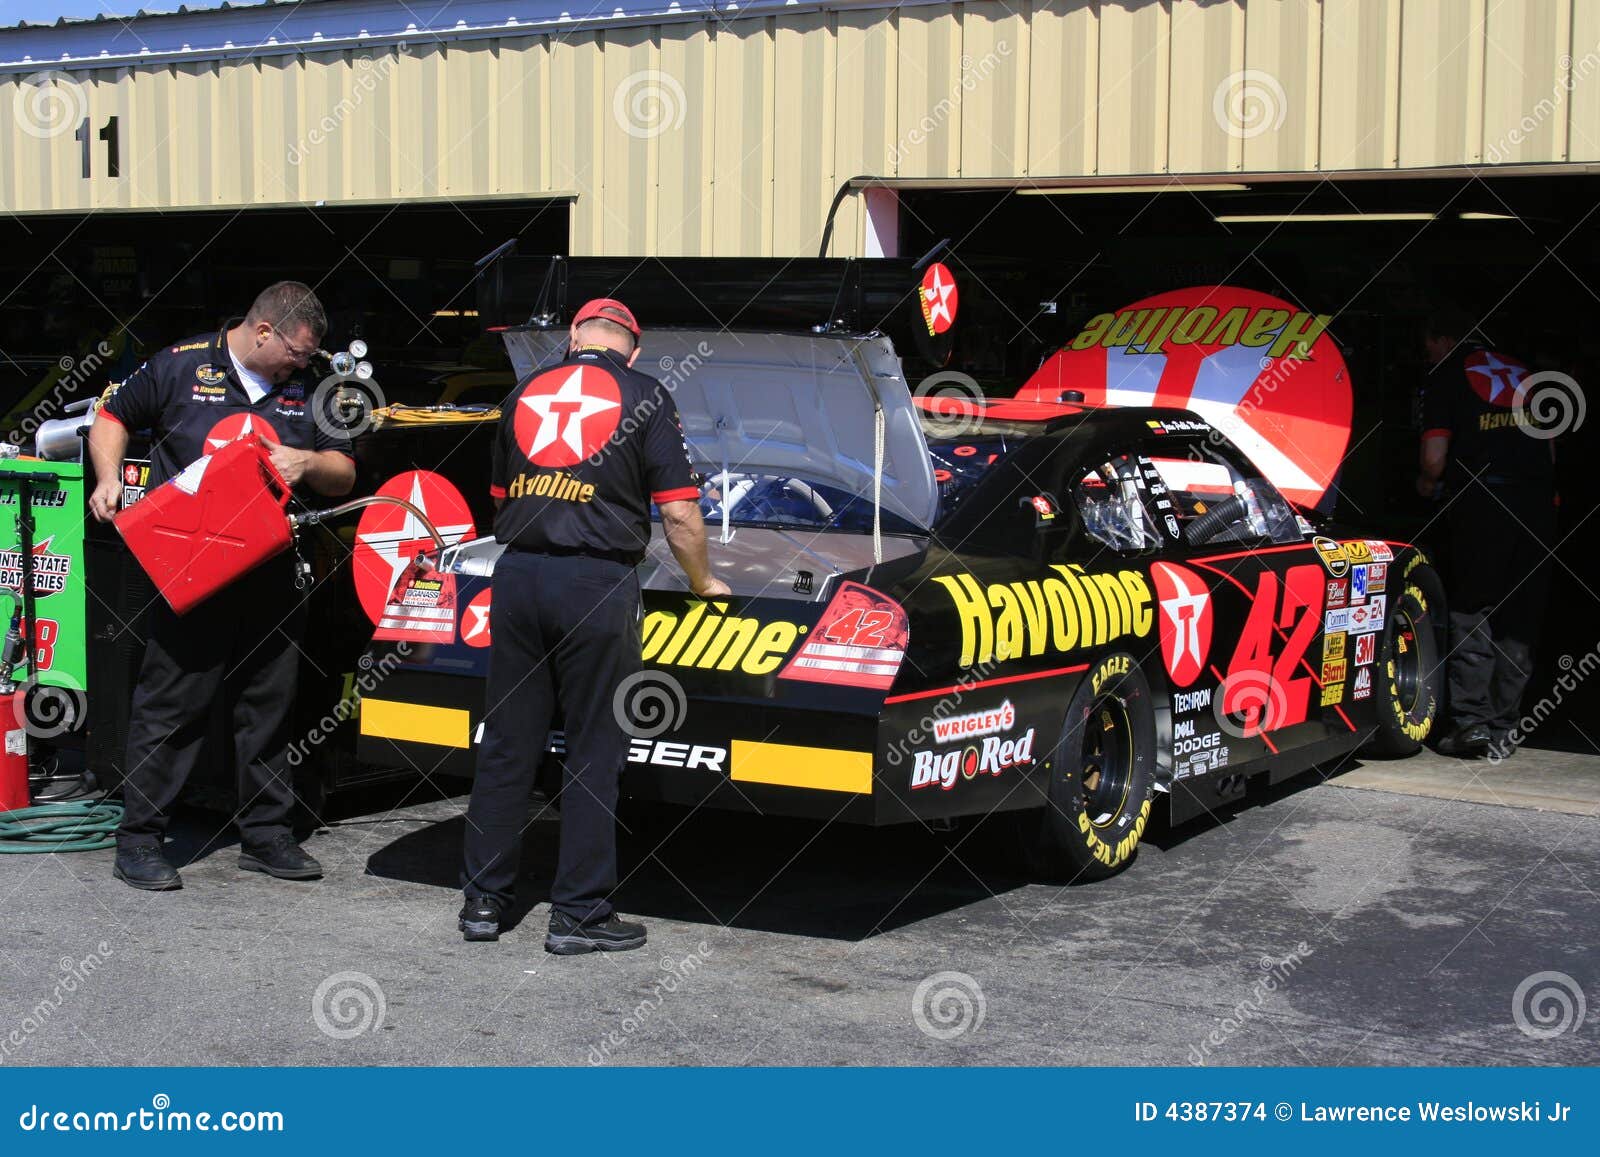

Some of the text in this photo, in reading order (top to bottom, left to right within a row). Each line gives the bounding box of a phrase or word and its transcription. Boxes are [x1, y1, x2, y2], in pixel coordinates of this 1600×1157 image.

[75, 115, 119, 178] 11
[1068, 306, 1333, 361] Havoline
[0, 553, 69, 573] NTESTATE
[1, 571, 64, 590] BATERIES
[824, 607, 895, 648] 42
[930, 563, 1154, 668] Havoline
[641, 600, 798, 675] oline
[1221, 564, 1327, 738] 42
[1356, 634, 1375, 665] 3M
[1091, 656, 1130, 697] EAGLE
[936, 701, 1014, 740] WRIGLEY'S
[1174, 688, 1211, 714] TECHRON
[1173, 732, 1221, 757] DODGE
[911, 750, 962, 791] Big
